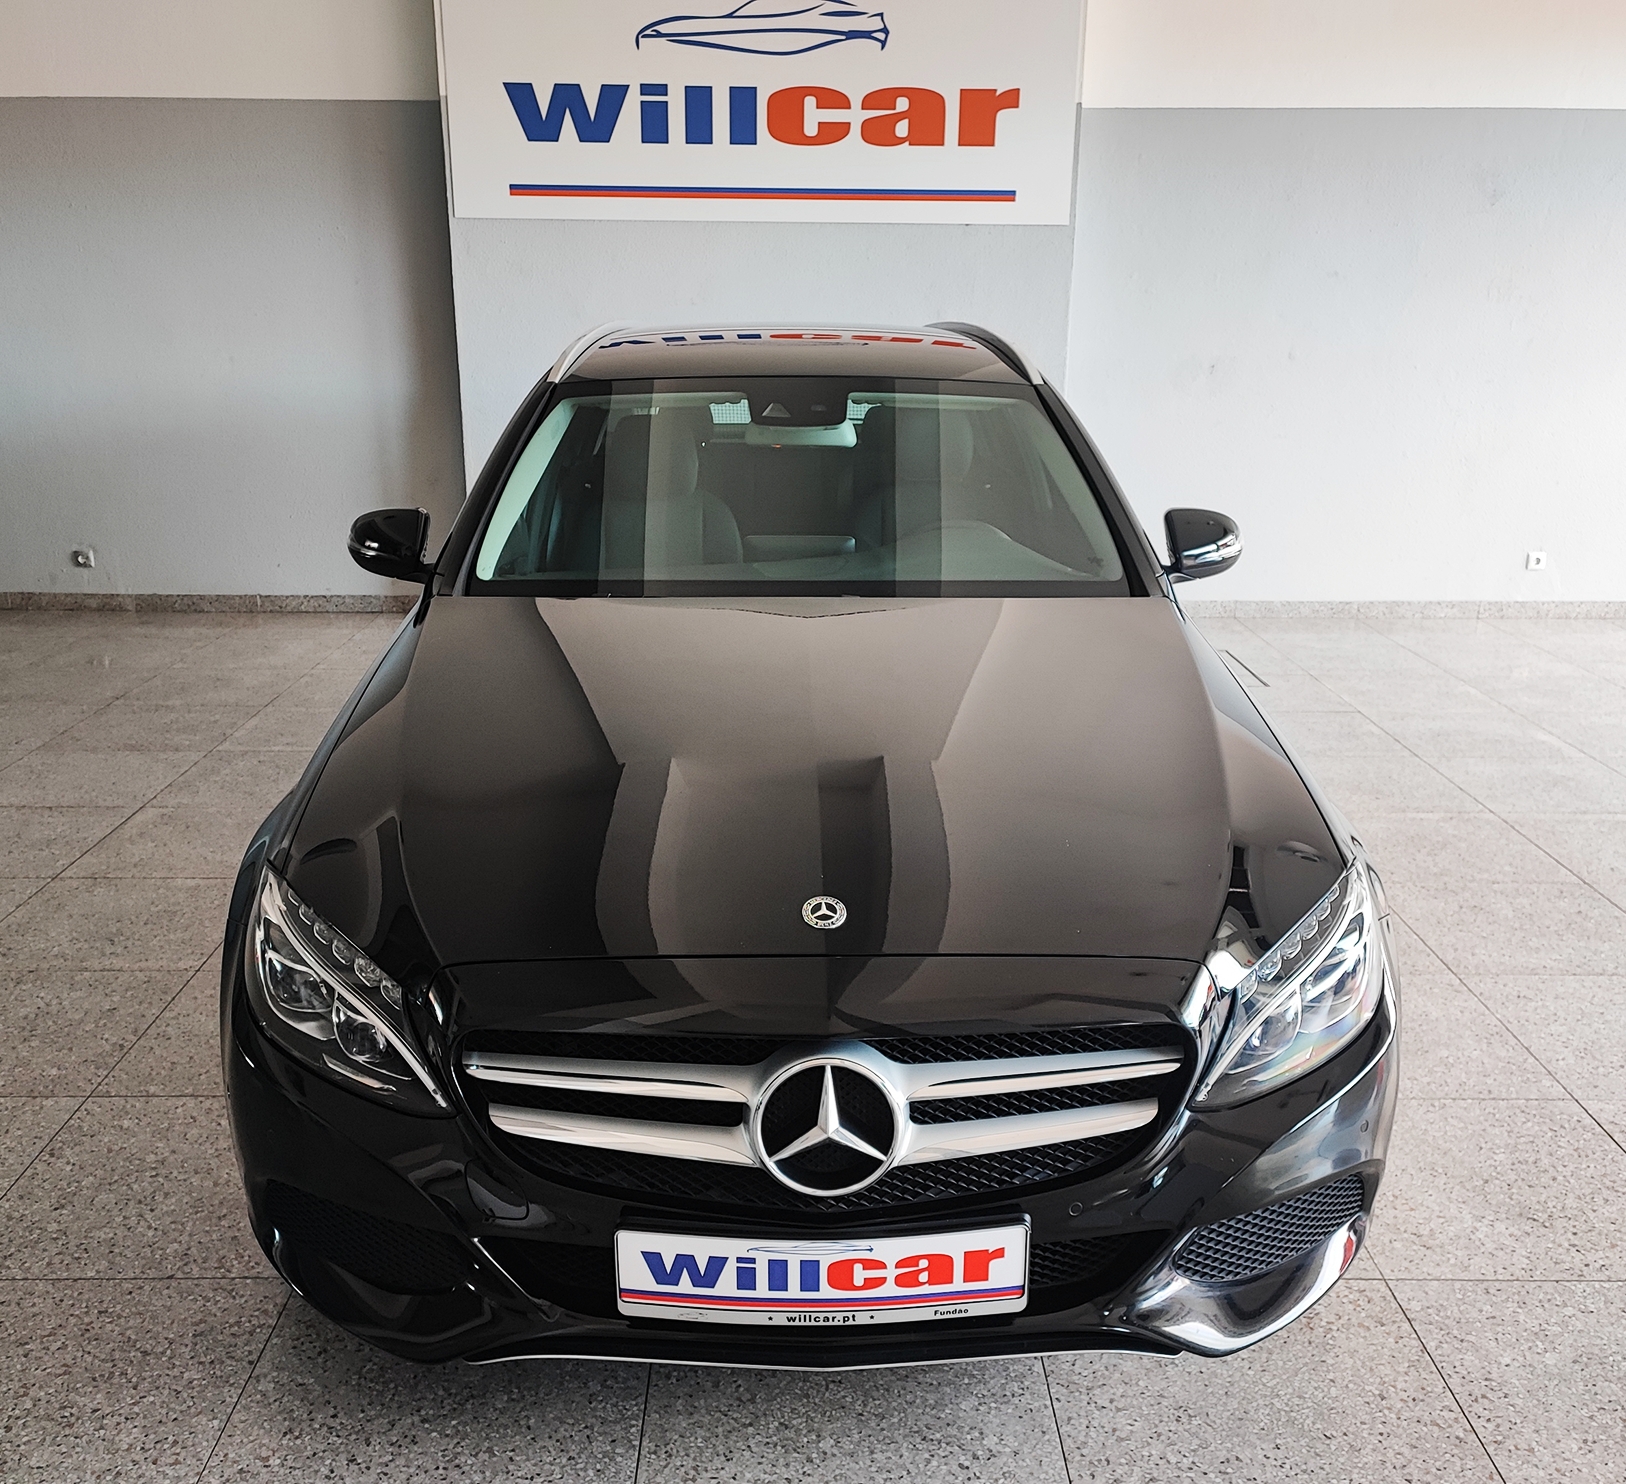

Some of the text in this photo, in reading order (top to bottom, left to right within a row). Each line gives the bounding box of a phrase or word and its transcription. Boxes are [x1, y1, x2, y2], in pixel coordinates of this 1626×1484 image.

[503, 82, 1021, 147] willcar
[640, 1246, 1006, 1292] willcar
[785, 1313, 857, 1324] willcar.pt
